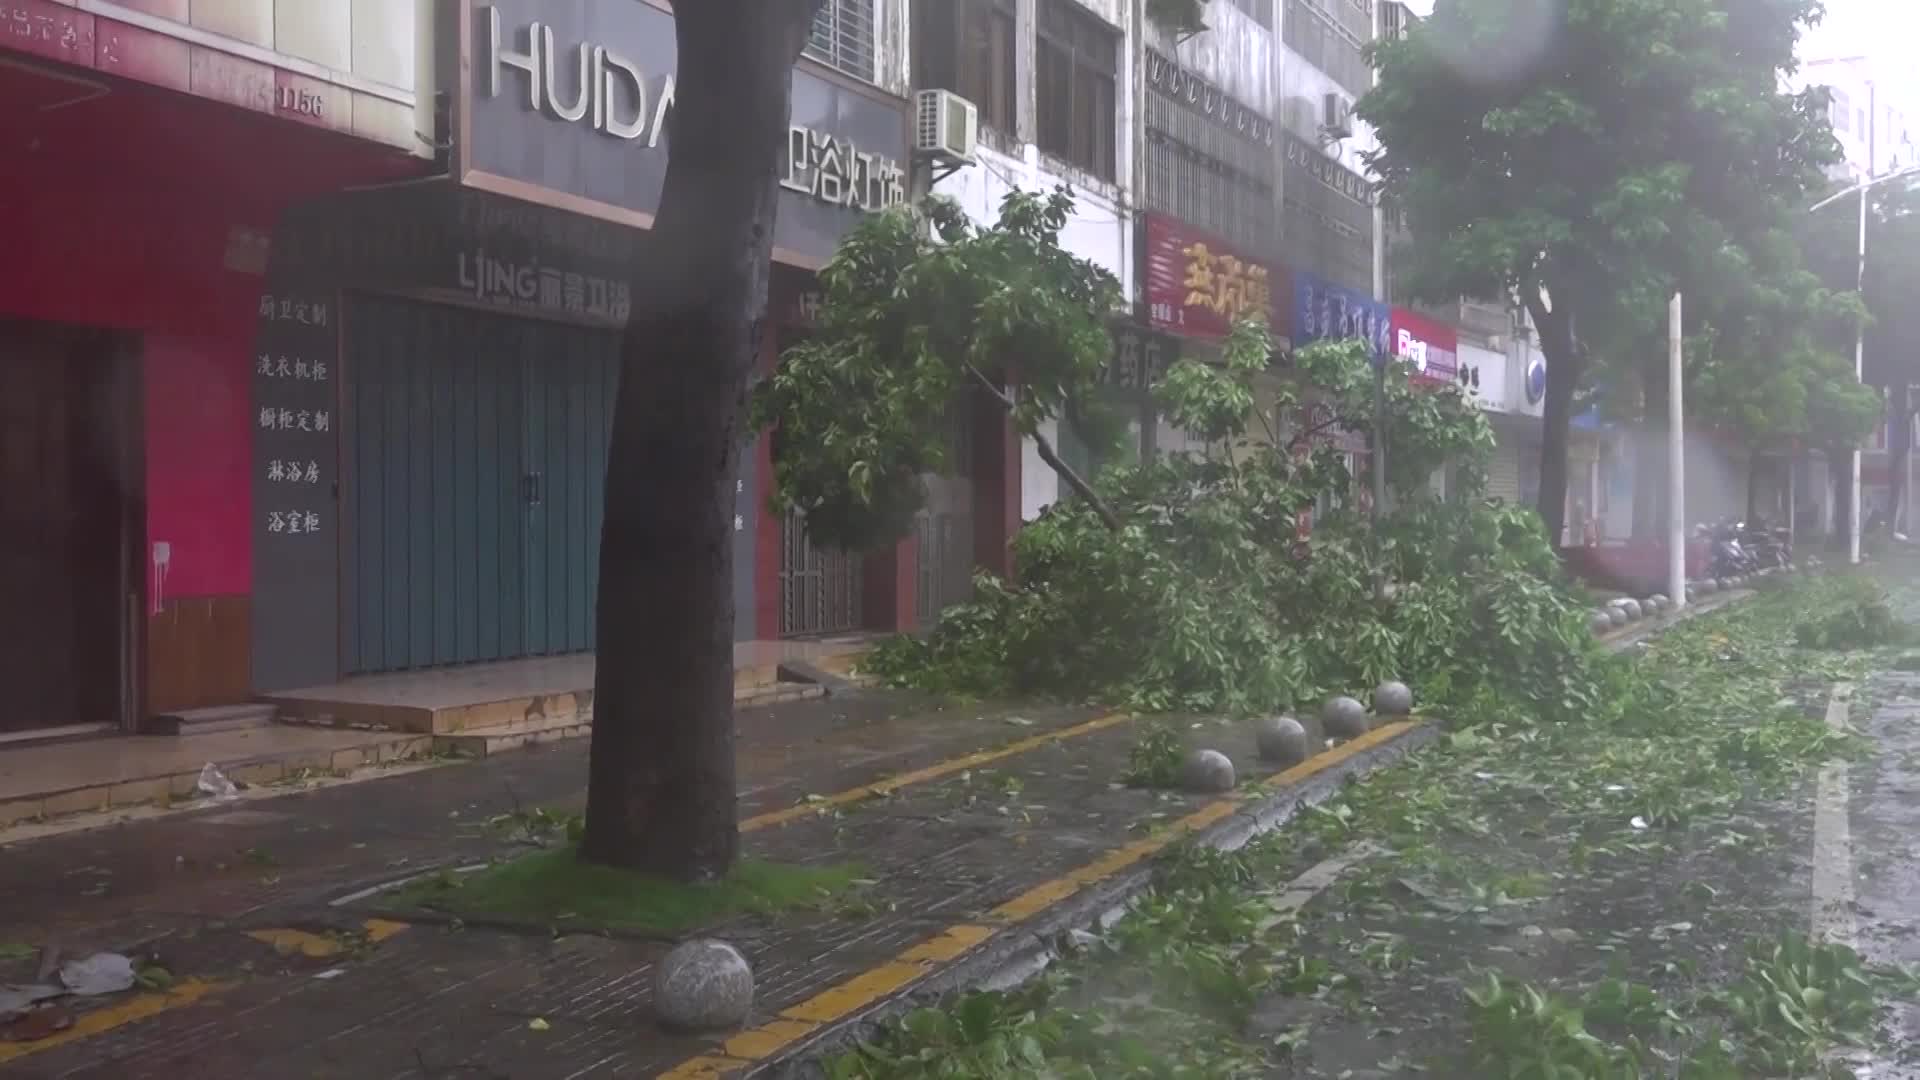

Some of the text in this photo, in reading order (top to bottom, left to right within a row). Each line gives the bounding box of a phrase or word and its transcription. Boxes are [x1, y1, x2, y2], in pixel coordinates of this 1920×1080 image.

[257, 353, 328, 381] 洗衣机柜
[260, 406, 329, 432] 橱柜定制
[267, 459, 320, 484] 淋浴房
[267, 509, 321, 534] 浴室柜
